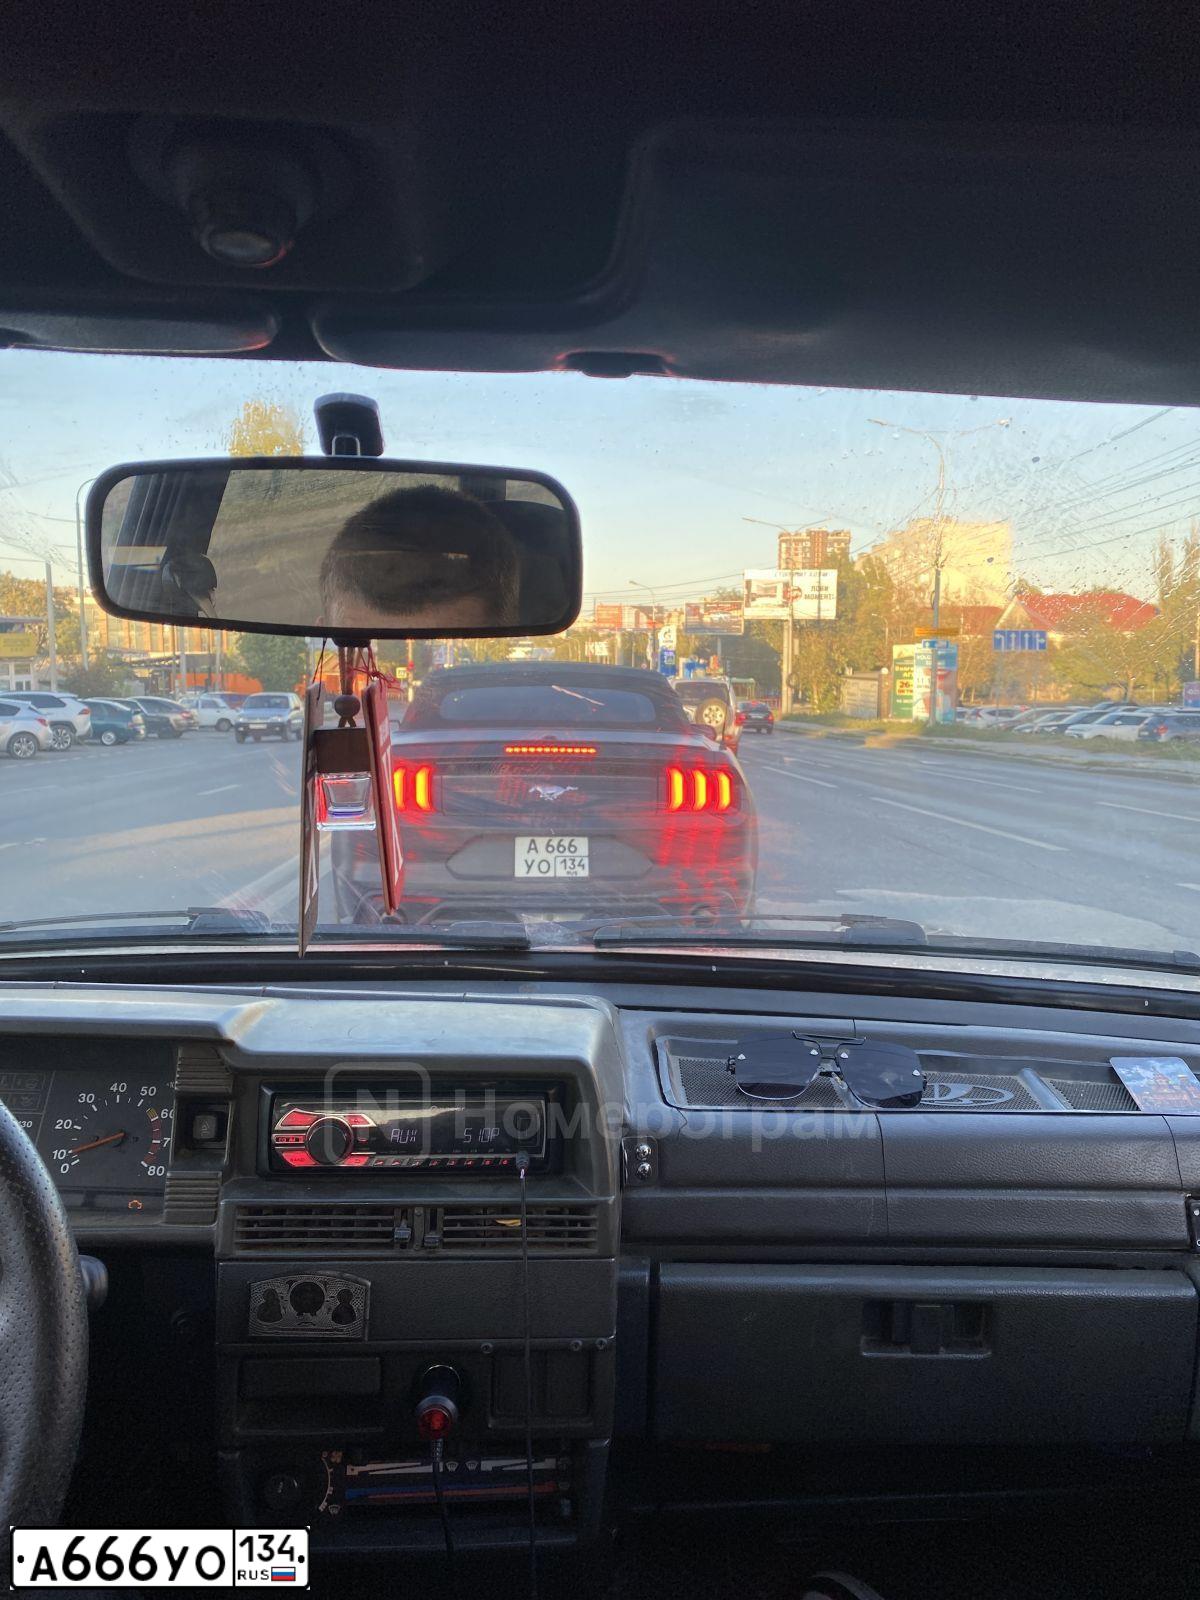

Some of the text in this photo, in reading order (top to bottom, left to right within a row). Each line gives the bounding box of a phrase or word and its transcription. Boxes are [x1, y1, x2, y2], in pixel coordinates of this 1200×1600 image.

[527, 839, 578, 854] А 666
[524, 859, 551, 875] УО
[560, 858, 585, 871] 134
[109, 1082, 127, 1093] 40
[140, 1086, 157, 1097] 50
[77, 1093, 95, 1104] 30
[54, 1119, 73, 1130] 20
[391, 1128, 418, 1144] AUX
[52, 1149, 67, 1160] 10
[60, 1163, 70, 1174] 0
[147, 1165, 165, 1177] 80
